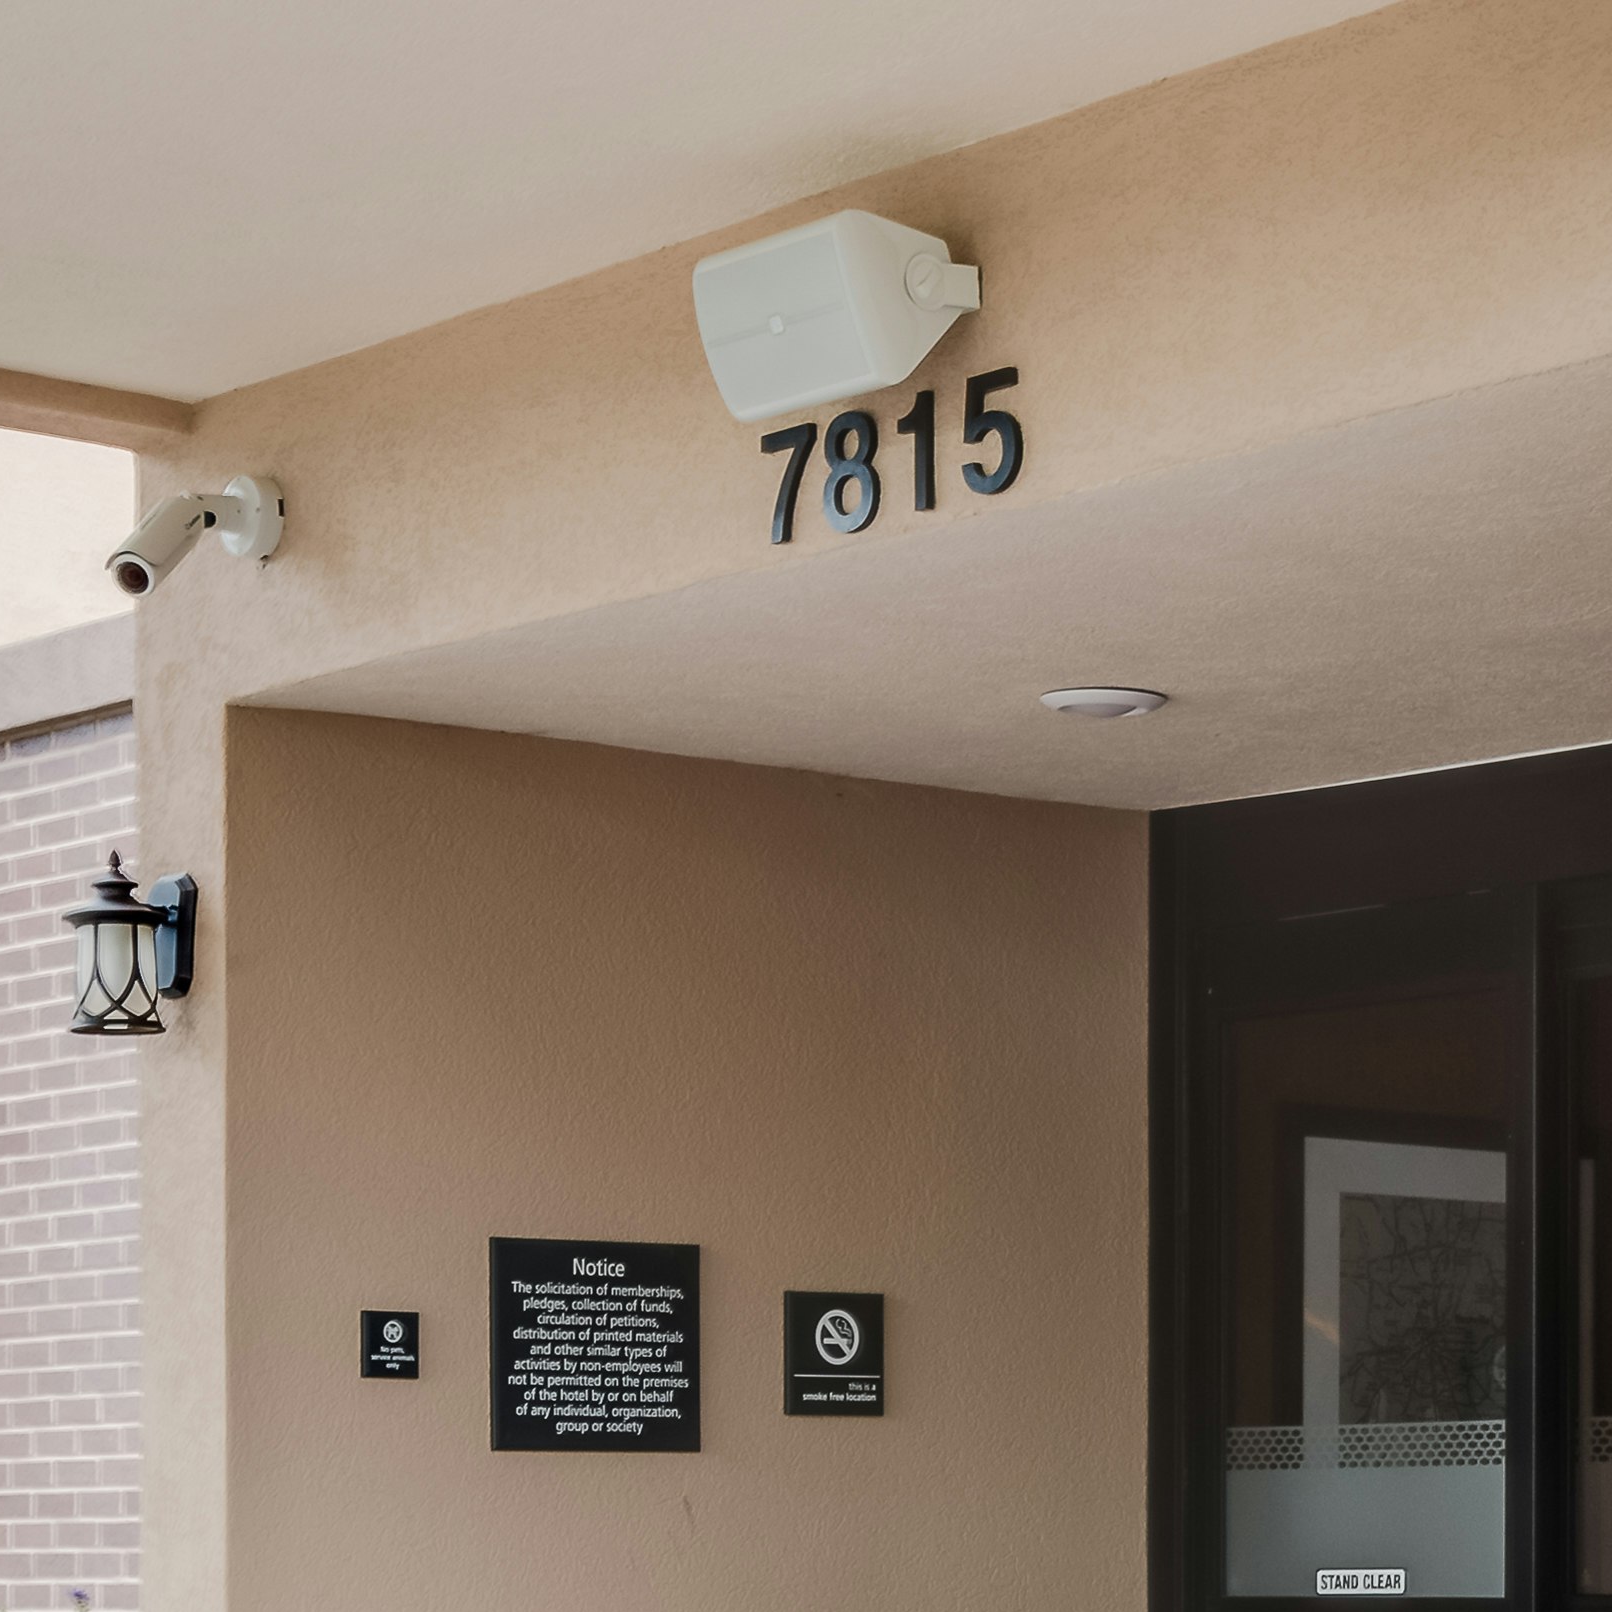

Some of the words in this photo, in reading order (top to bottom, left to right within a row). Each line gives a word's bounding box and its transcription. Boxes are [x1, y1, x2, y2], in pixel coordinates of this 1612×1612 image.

[760, 366, 1023, 545] 7815
[573, 1257, 625, 1277] Notice
[512, 1281, 532, 1294] The
[535, 1282, 593, 1295] solicitation
[596, 1284, 608, 1296] of
[611, 1286, 684, 1300] memberships,
[523, 1297, 569, 1312] pledges,
[572, 1299, 623, 1311] collection
[626, 1300, 637, 1312] of
[640, 1300, 673, 1314] funds,
[537, 1313, 592, 1325] circulation
[596, 1314, 607, 1326] of
[610, 1315, 660, 1329] petitions,
[513, 1327, 575, 1340] distribution
[578, 1328, 590, 1341] of
[594, 1330, 632, 1343] printed
[635, 1331, 683, 1343] materials
[530, 1343, 551, 1356] and
[554, 1344, 583, 1356] other
[587, 1345, 620, 1357] similar
[624, 1347, 652, 1359] types
[655, 1345, 667, 1357] of
[514, 1359, 560, 1371] activities
[564, 1359, 577, 1373] by
[580, 1359, 661, 1375] non-employees
[664, 1361, 682, 1373] will
[508, 1374, 526, 1386] not
[530, 1374, 544, 1386] be
[548, 1374, 601, 1388] permitted
[604, 1377, 619, 1387] on
[622, 1376, 640, 1388] the
[643, 1378, 689, 1390] premises
[849, 1382, 862, 1391] this
[864, 1383, 870, 1391] is
[524, 1389, 536, 1401] of
[539, 1389, 557, 1401] the
[560, 1390, 589, 1401] hotel
[592, 1390, 604, 1404] by
[607, 1392, 619, 1402] or
[622, 1393, 636, 1402] on
[640, 1390, 674, 1402] behalf
[802, 1392, 827, 1401] smoke
[829, 1393, 844, 1401] free
[846, 1393, 876, 1401] location
[516, 1404, 528, 1416] of
[531, 1406, 550, 1419] any
[553, 1405, 608, 1418] individual,
[612, 1406, 682, 1420] organization,
[556, 1421, 589, 1433] group
[592, 1422, 603, 1432] or
[606, 1420, 644, 1435] society
[1321, 1574, 1358, 1590] STAND
[1363, 1574, 1401, 1589] CLEAR
